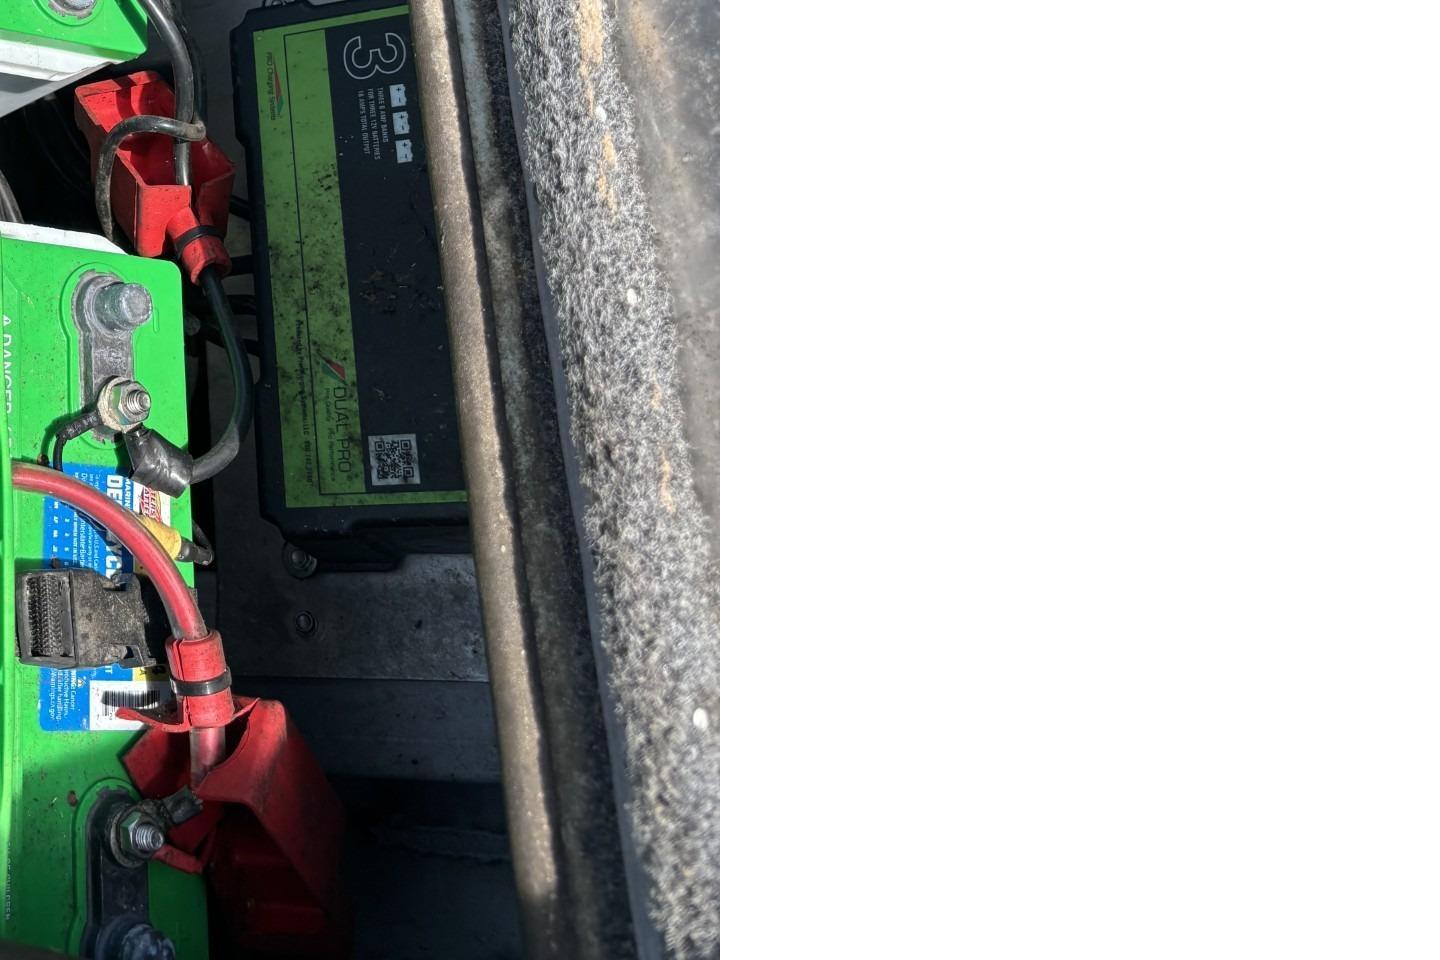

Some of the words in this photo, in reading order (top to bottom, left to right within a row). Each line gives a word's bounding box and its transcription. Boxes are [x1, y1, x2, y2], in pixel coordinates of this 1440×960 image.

[343, 32, 407, 80] 3
[360, 116, 368, 131] TOTAL
[333, 386, 350, 432] DUAL
[336, 438, 353, 473] PRO
